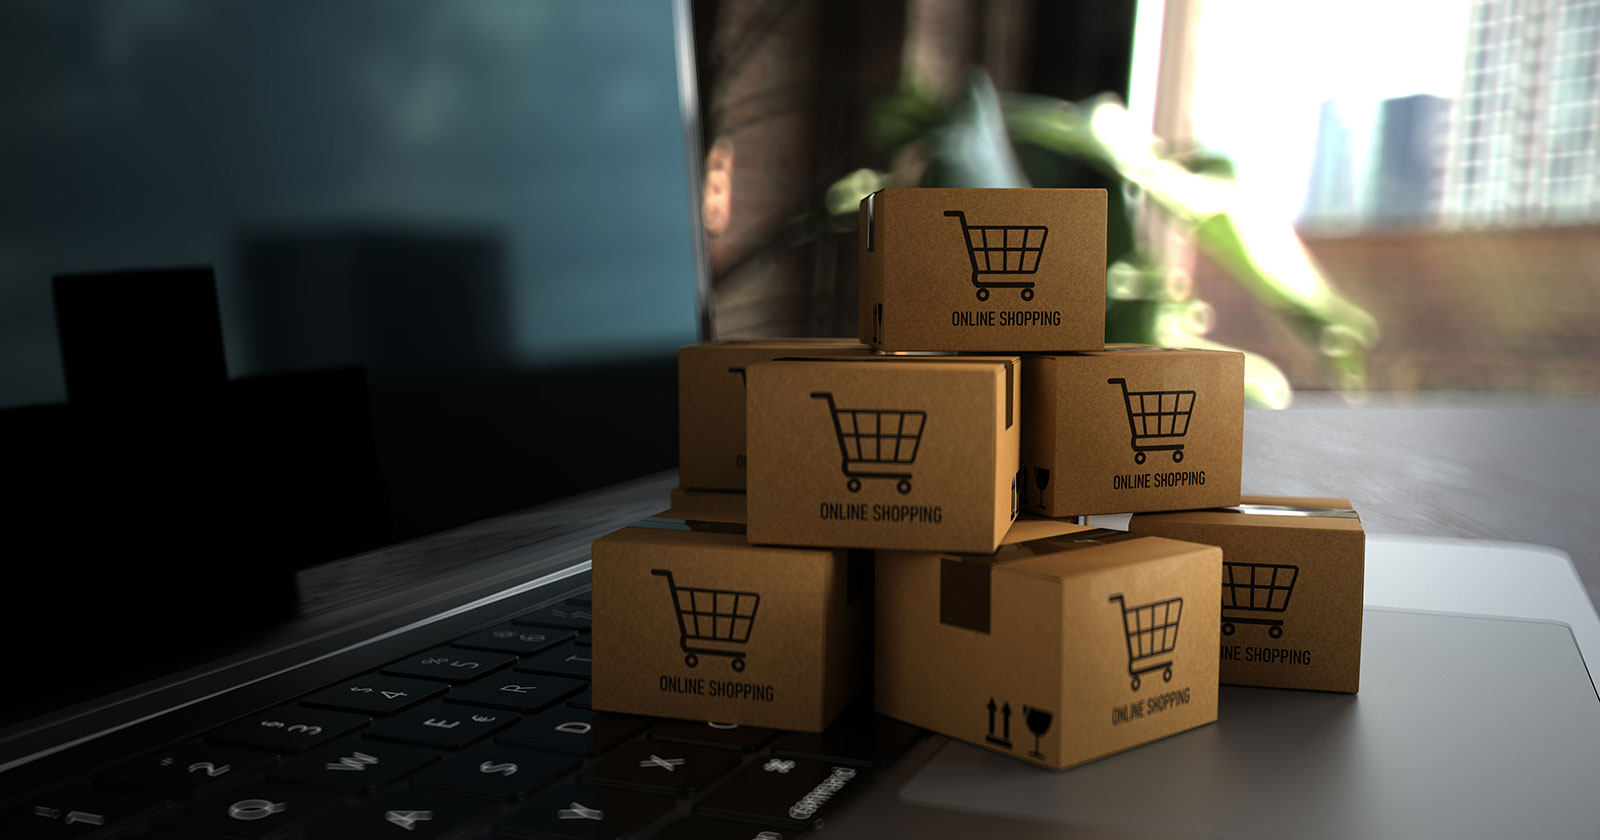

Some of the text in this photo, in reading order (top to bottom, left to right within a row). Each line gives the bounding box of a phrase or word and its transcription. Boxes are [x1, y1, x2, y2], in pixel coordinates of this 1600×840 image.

[952, 310, 1061, 327] ONLINE SHOPPING
[1112, 470, 1206, 490] ONLINE SHOPPING
[820, 502, 943, 524] ONLINE SHOPPING
[519, 633, 546, 642] 6
[421, 656, 448, 665] %
[1219, 645, 1311, 666] INE SHOPPING
[450, 660, 480, 669] 5
[380, 686, 409, 699] 4
[499, 684, 537, 694] R
[659, 675, 774, 702] ONLINE SHOPPING
[1111, 686, 1191, 727] ONLINE SHOPPING
[423, 717, 461, 729] E
[471, 714, 496, 723] €
[287, 724, 323, 736] 3
[554, 720, 592, 736] D
[187, 761, 233, 778] 2
[325, 751, 380, 772] W
[479, 760, 519, 776] S
[639, 754, 686, 772] X
[64, 810, 106, 826] 1
[227, 798, 289, 821] Q
[556, 801, 605, 821] Y
[384, 809, 434, 831] A
